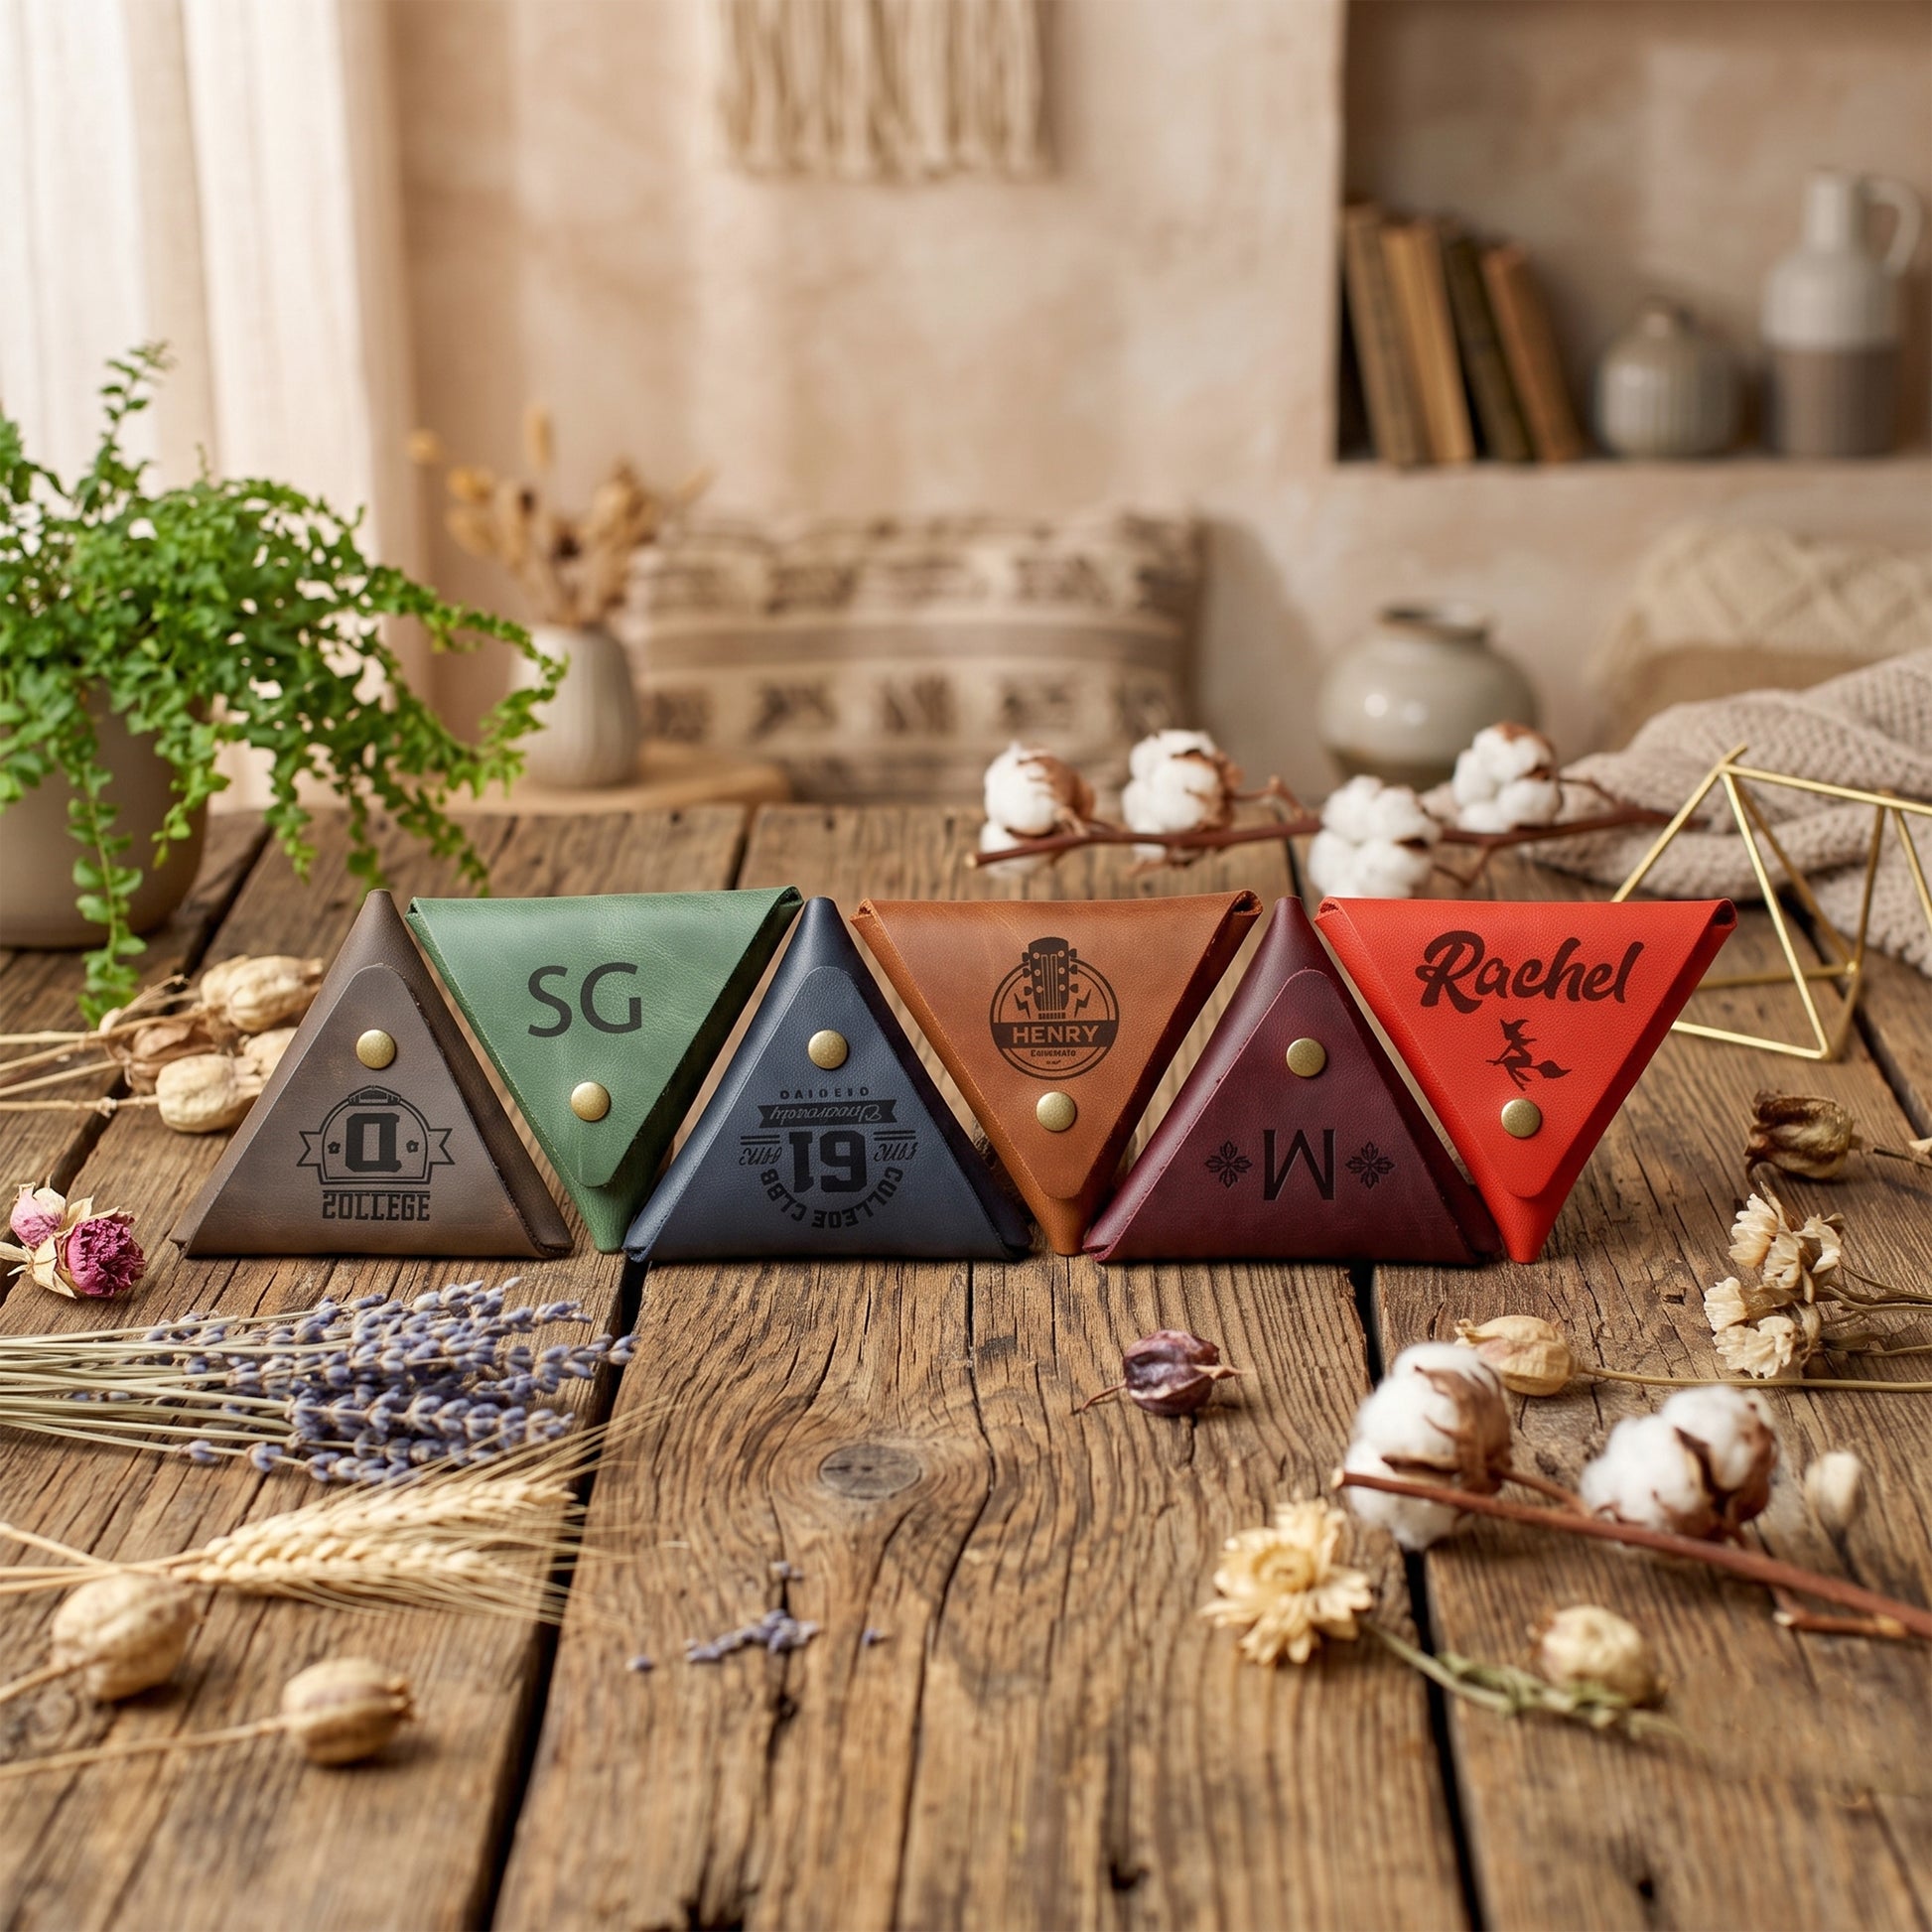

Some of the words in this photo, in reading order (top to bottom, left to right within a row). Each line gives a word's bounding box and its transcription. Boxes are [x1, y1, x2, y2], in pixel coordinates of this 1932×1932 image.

[528, 962, 642, 1037] SG
[1415, 930, 1645, 1014] Rachel
[1012, 1025, 1099, 1044] HENRY
